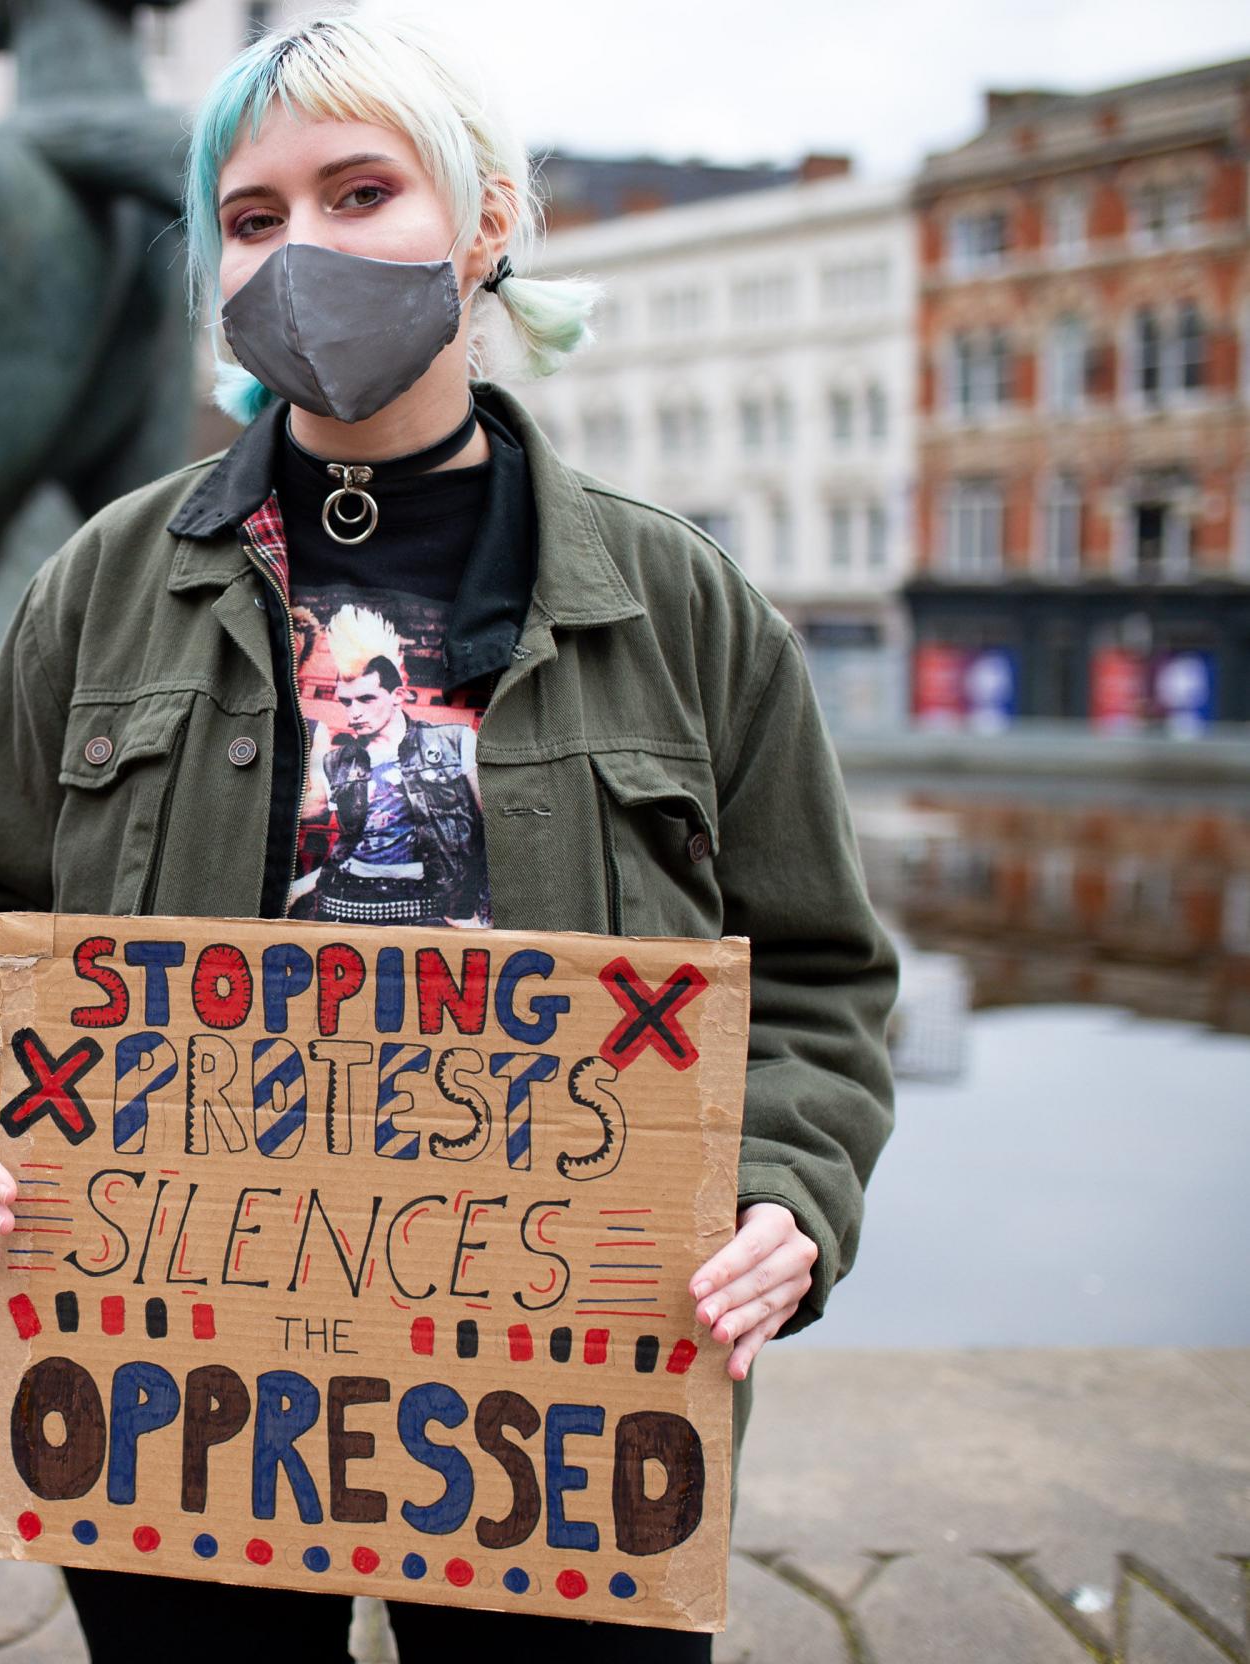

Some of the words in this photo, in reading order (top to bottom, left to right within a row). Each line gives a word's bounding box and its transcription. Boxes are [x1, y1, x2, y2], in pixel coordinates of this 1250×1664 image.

[70, 936, 571, 1043] STOPPING
[111, 1033, 628, 1182] PROTESTS
[65, 1169, 572, 1310] SILENCES
[275, 1316, 359, 1355] THE
[10, 1355, 706, 1557] OPPRESSED
